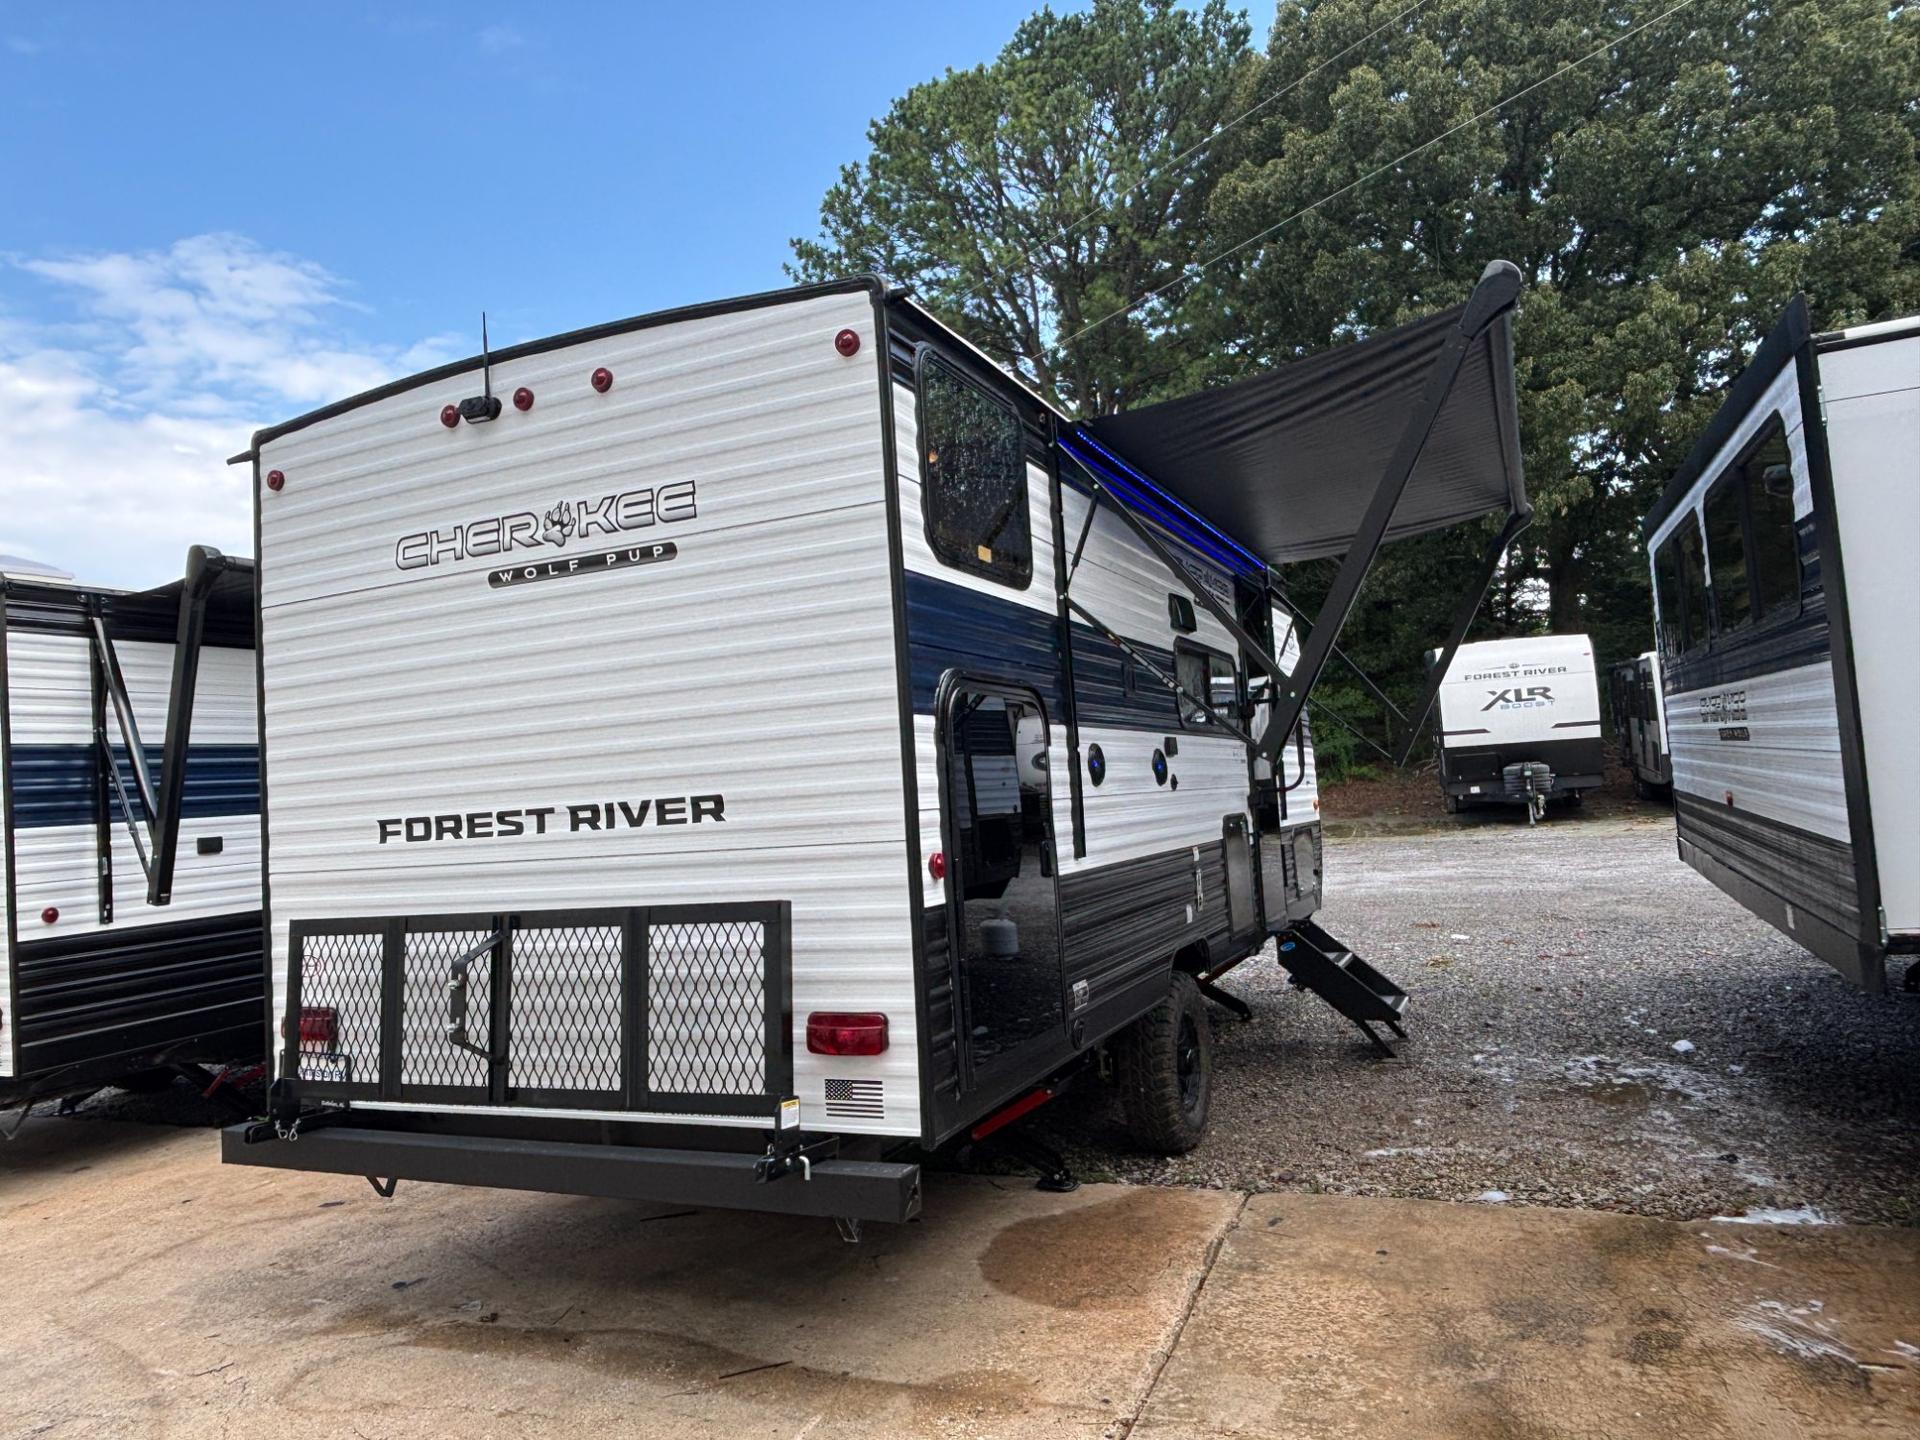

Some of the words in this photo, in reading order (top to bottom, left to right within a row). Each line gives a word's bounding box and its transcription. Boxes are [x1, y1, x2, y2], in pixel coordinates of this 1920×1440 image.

[395, 480, 698, 570] CHERKEE
[498, 560, 579, 583] WOLF
[606, 545, 664, 566] PUP
[1464, 670, 1520, 681] FOREST
[1524, 666, 1567, 676] RIVER
[1480, 686, 1555, 711] XLR
[1499, 700, 1554, 710] BOOST
[376, 806, 555, 844] FOREST
[566, 793, 727, 832] RIVER
